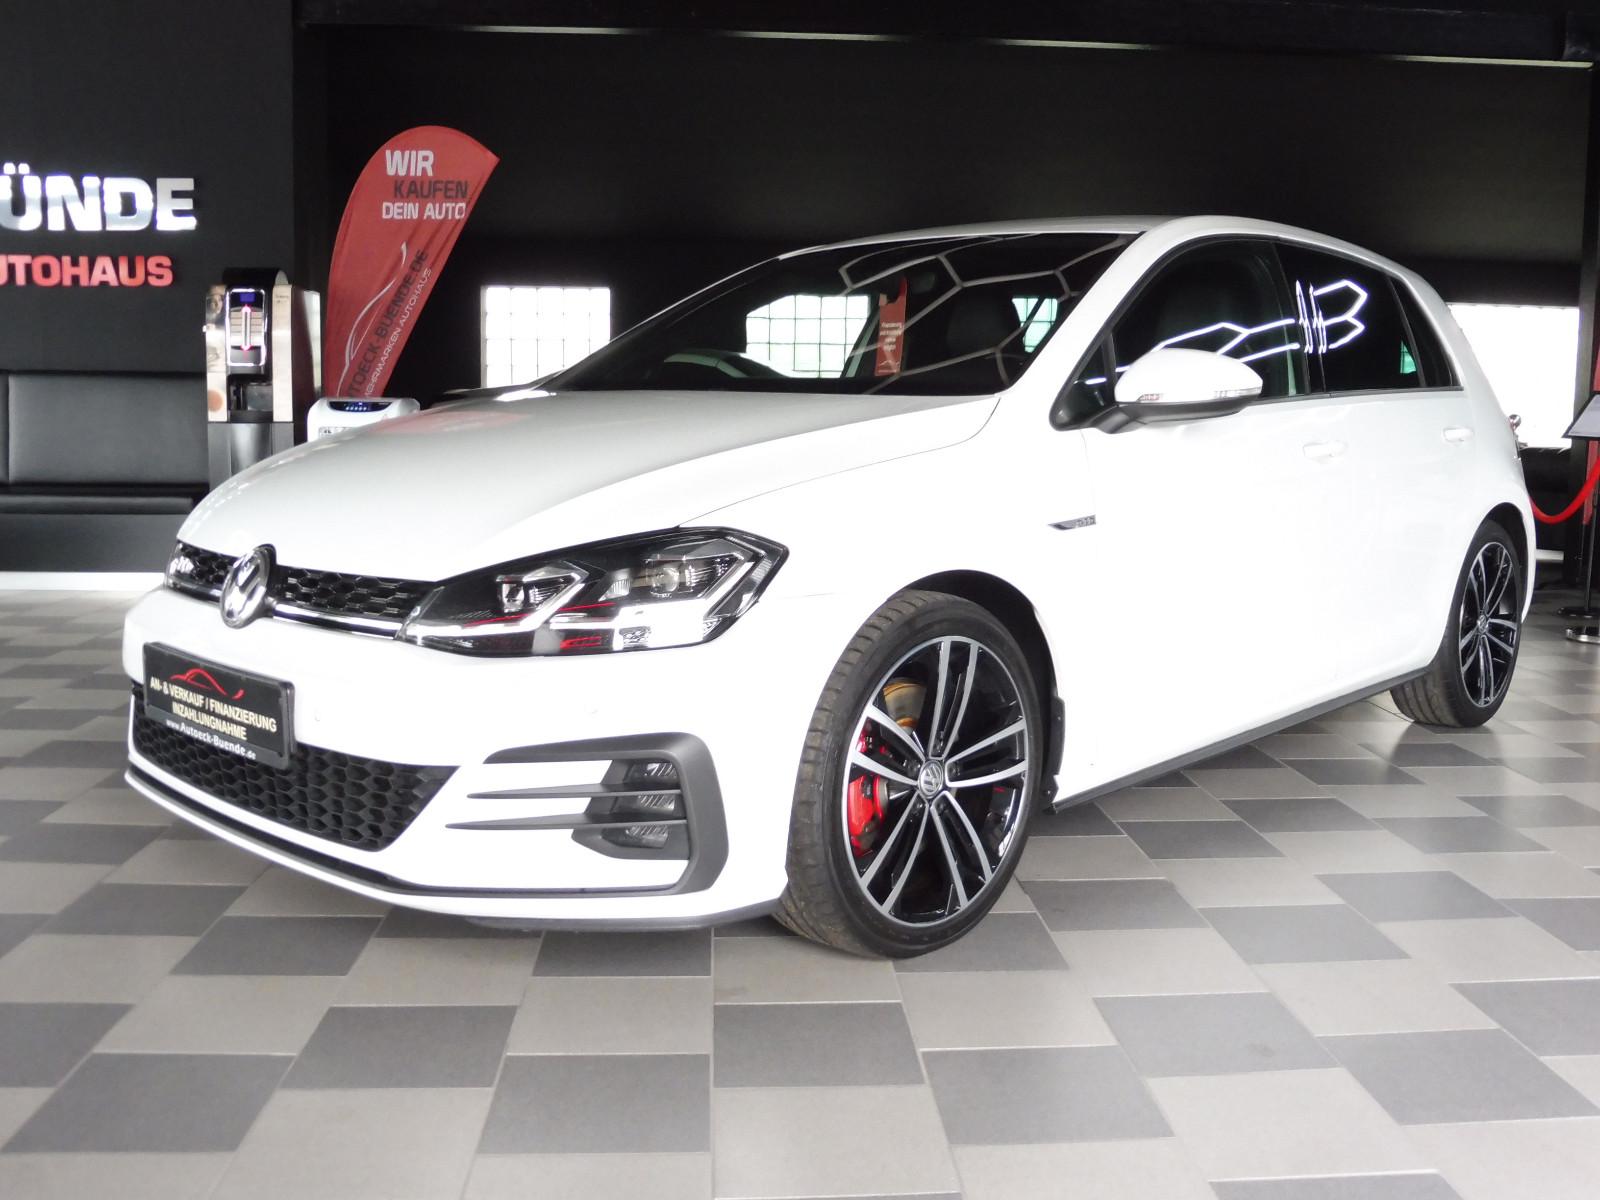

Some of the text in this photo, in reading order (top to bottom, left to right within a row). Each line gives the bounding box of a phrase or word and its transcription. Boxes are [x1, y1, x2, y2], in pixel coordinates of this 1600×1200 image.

[385, 149, 434, 176] WIR
[394, 180, 468, 199] KAUFEN
[382, 202, 467, 219] DEIN AUTO
[400, 267, 432, 327] AUTOHAUS
[348, 249, 429, 398] TOECK-BUENDE.DE
[150, 676, 162, 691] AN-
[169, 683, 204, 707] VERKAUF
[209, 698, 277, 733] FINANZIERUNG
[172, 701, 247, 740] INZAHLUNGNAHME
